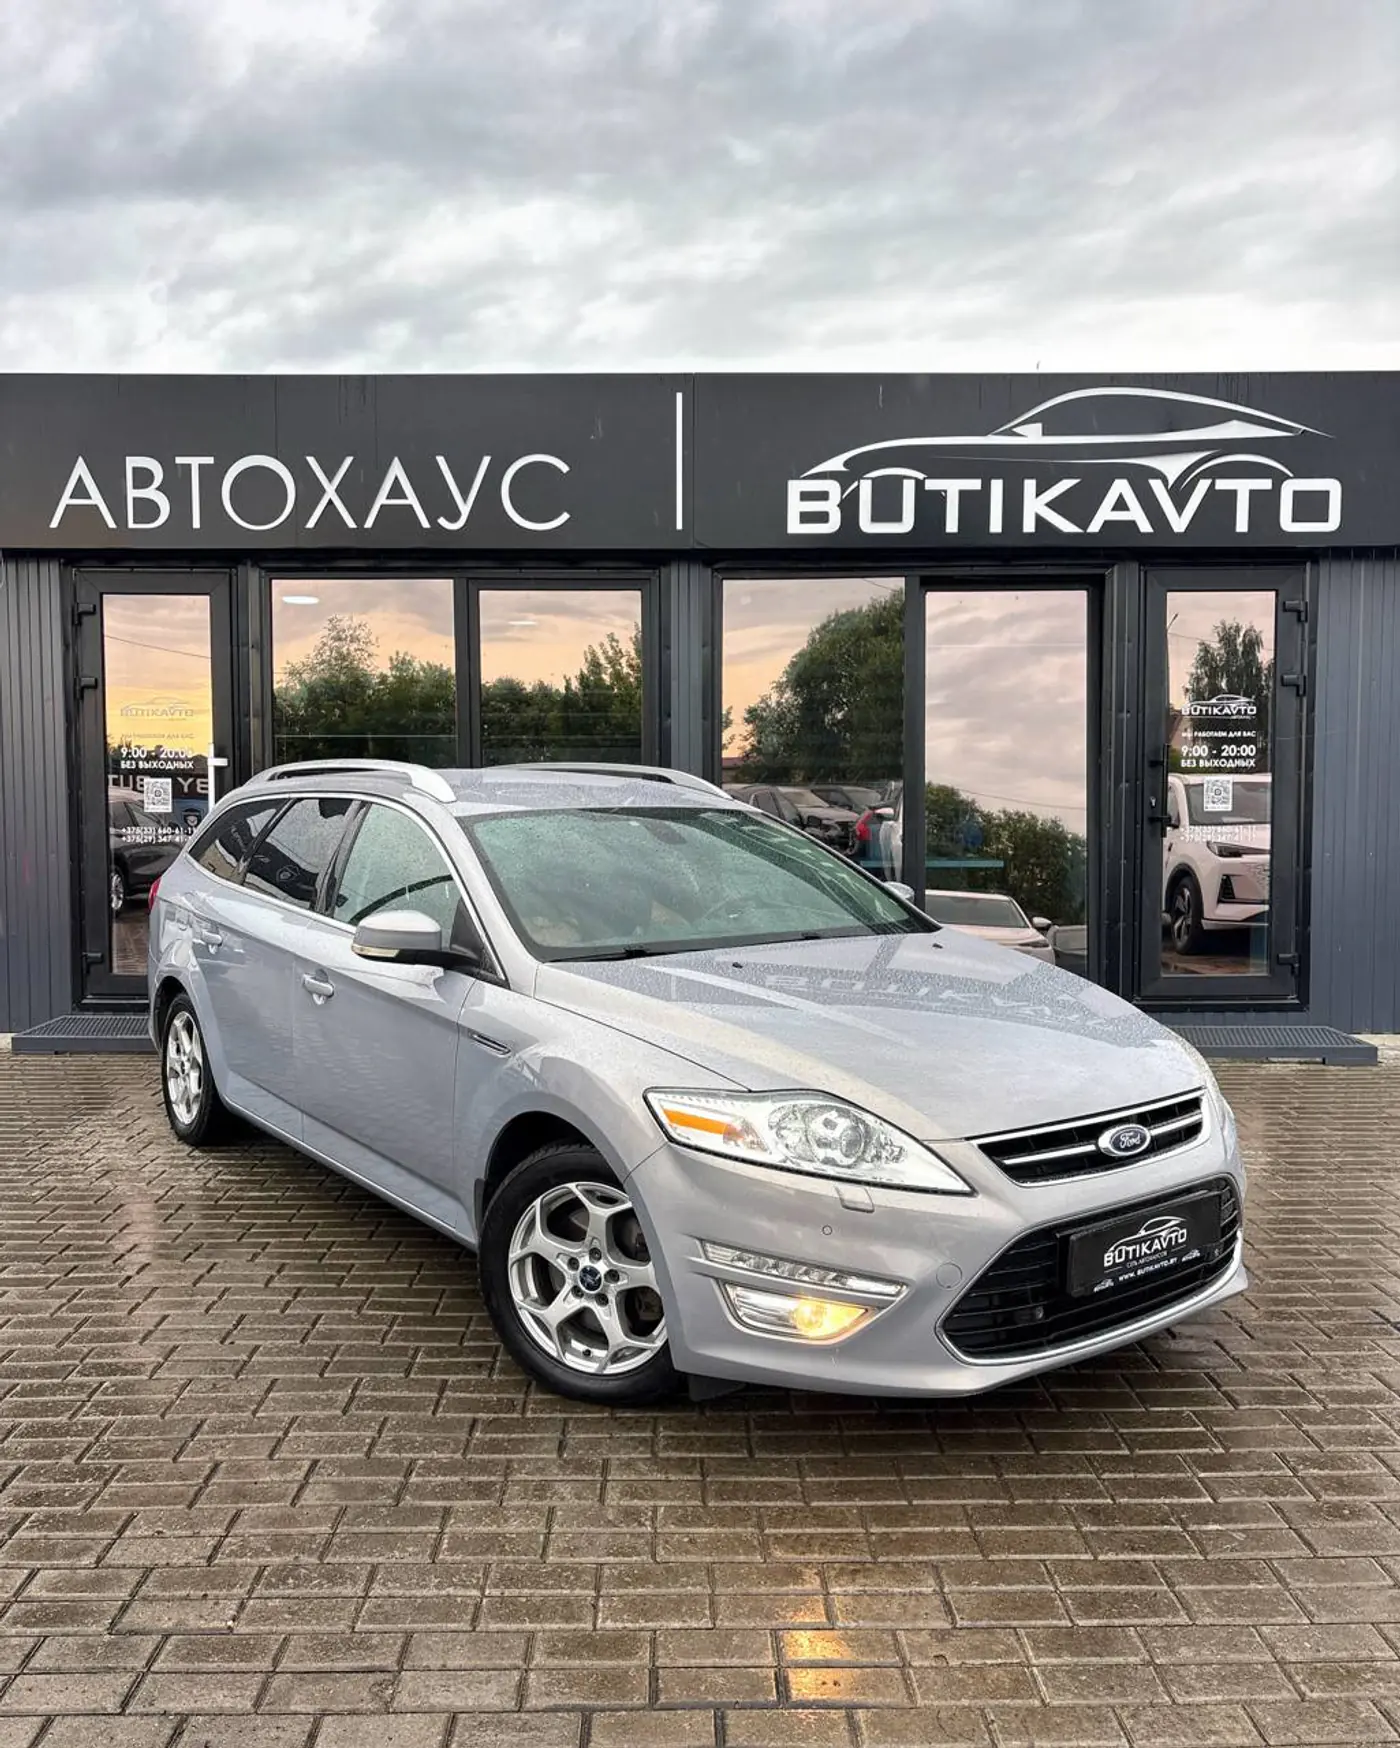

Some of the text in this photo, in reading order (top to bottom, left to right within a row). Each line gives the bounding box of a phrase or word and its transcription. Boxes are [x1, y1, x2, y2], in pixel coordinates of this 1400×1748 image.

[49, 453, 571, 531] АВТОХАУС
[786, 475, 1343, 535] BUTIKAVTO
[121, 747, 148, 758] 9:00
[1181, 745, 1209, 757] 9:00
[1221, 745, 1256, 757] 20:00
[121, 760, 194, 770] БЕЗ ВЫХОДНЫХ
[1181, 759, 1256, 768] БЕЗ ВЫХОДНЫХ
[1119, 1133, 1142, 1149] Ford
[1103, 1229, 1187, 1267] BUTIKAVTO
